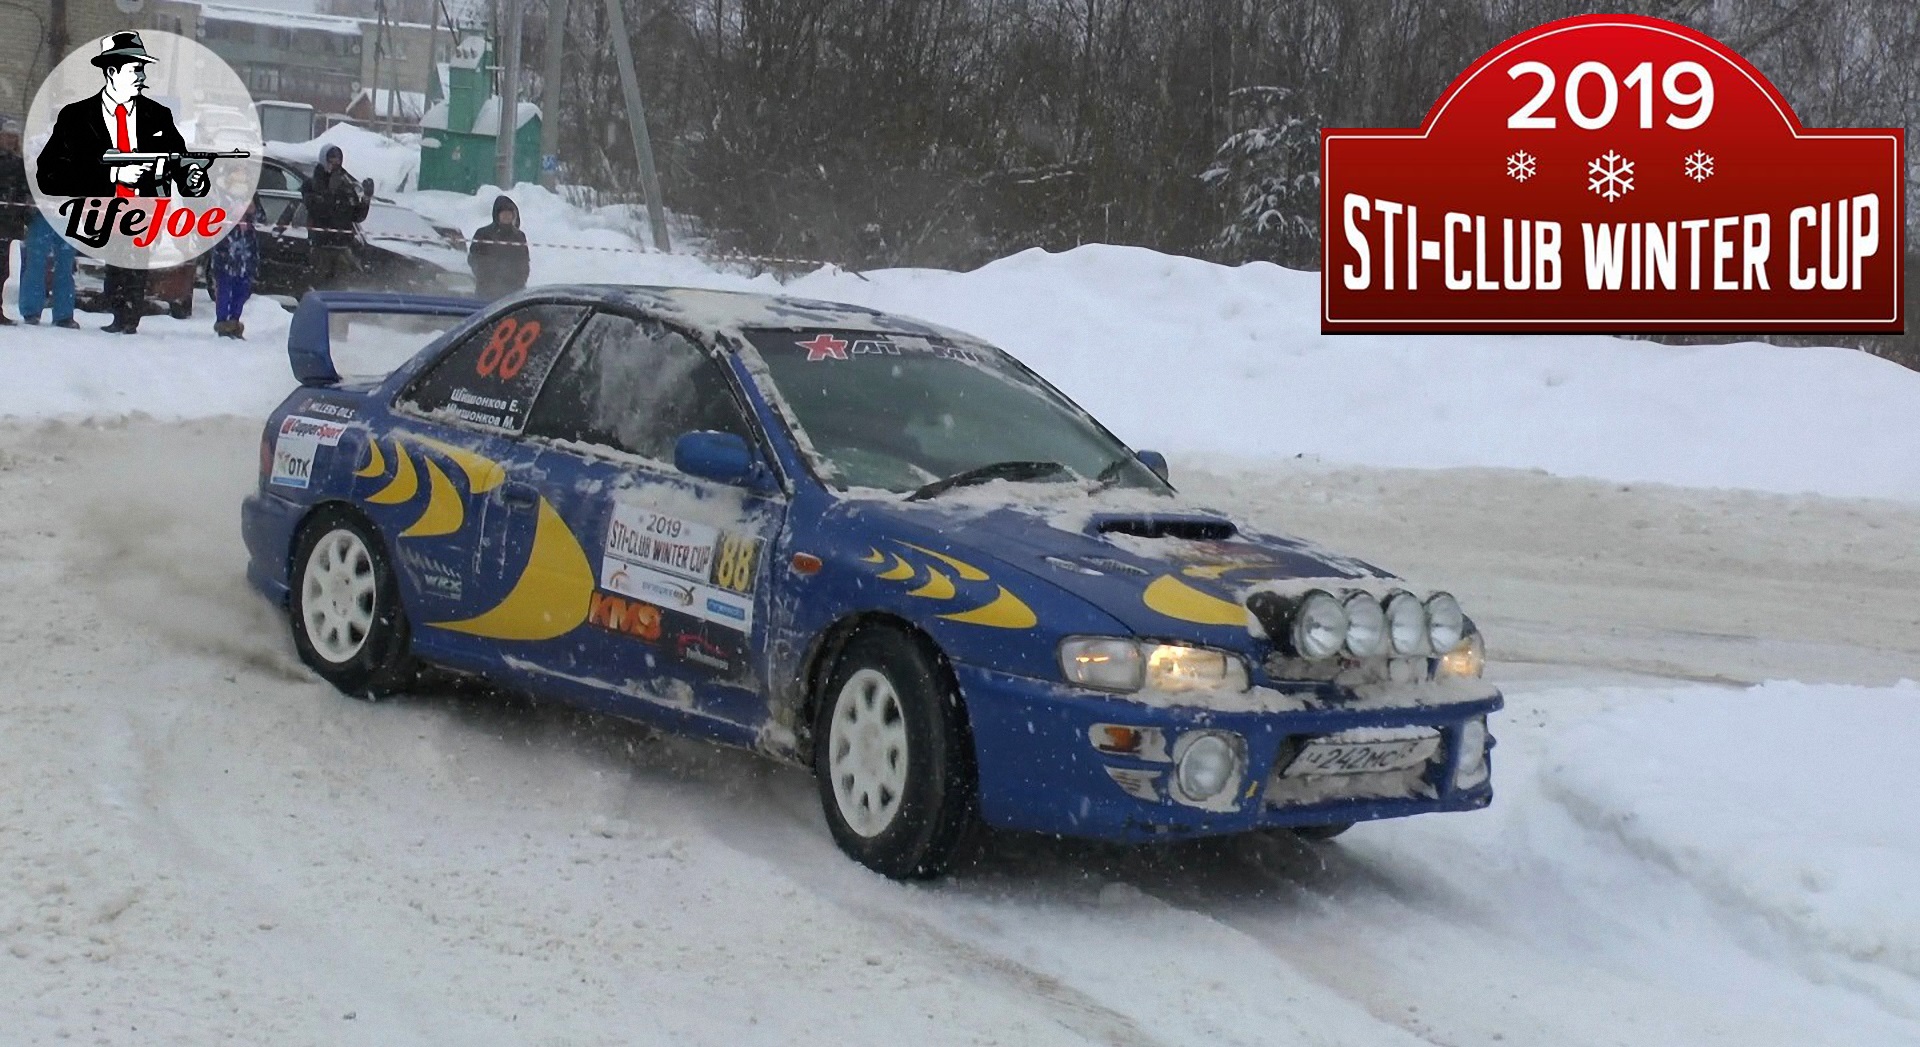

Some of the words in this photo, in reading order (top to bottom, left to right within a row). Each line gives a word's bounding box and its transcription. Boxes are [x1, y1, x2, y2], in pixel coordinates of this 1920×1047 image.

[475, 317, 542, 381] 88
[450, 387, 508, 411] Шишонков
[609, 519, 652, 559] STI-CLUB
[651, 539, 691, 568] WINTER
[689, 543, 713, 574] CUP
[646, 513, 682, 538] 2019
[717, 535, 754, 592] 88
